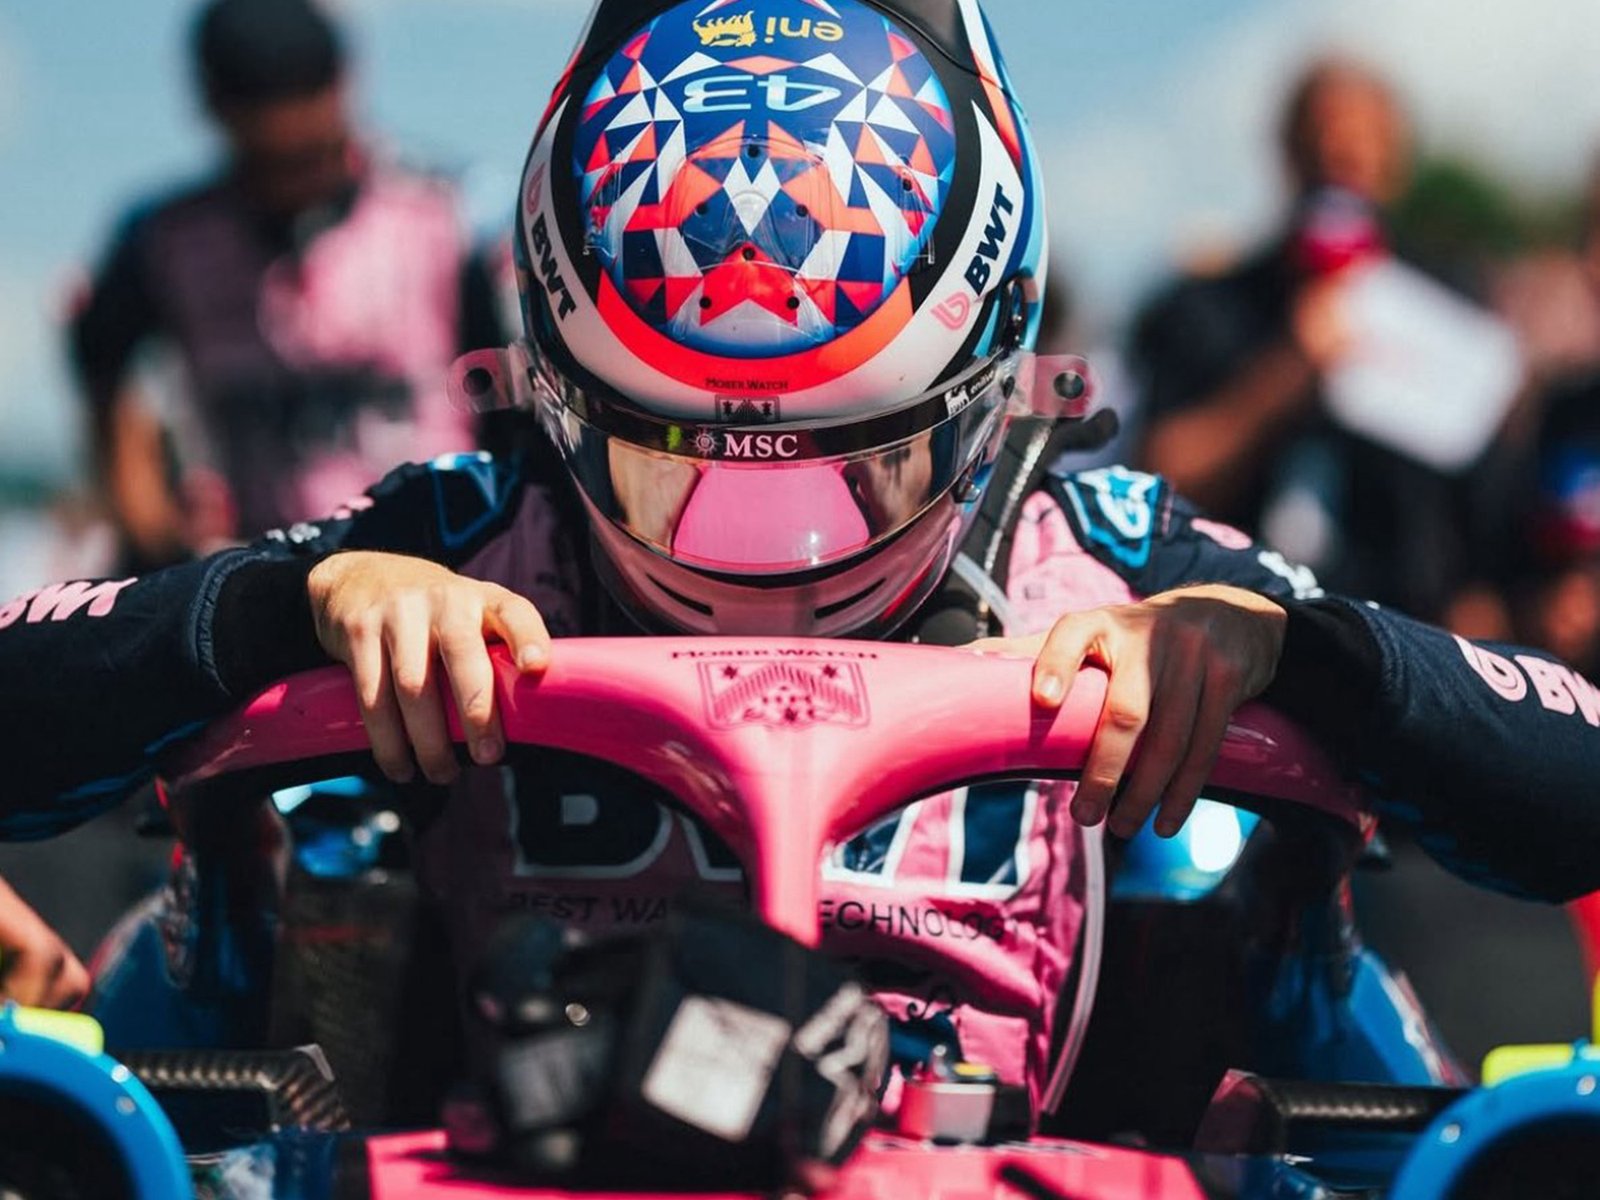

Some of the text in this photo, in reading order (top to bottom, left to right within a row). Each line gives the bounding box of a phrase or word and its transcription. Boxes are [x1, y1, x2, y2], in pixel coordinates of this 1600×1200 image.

[764, 16, 844, 43] eni
[682, 74, 842, 113] 43
[963, 182, 1014, 297] BWT
[531, 211, 577, 321] BWT
[723, 433, 798, 458] MSC
[777, 648, 878, 660] WATCH
[819, 899, 1018, 940] ECHNOLOG
